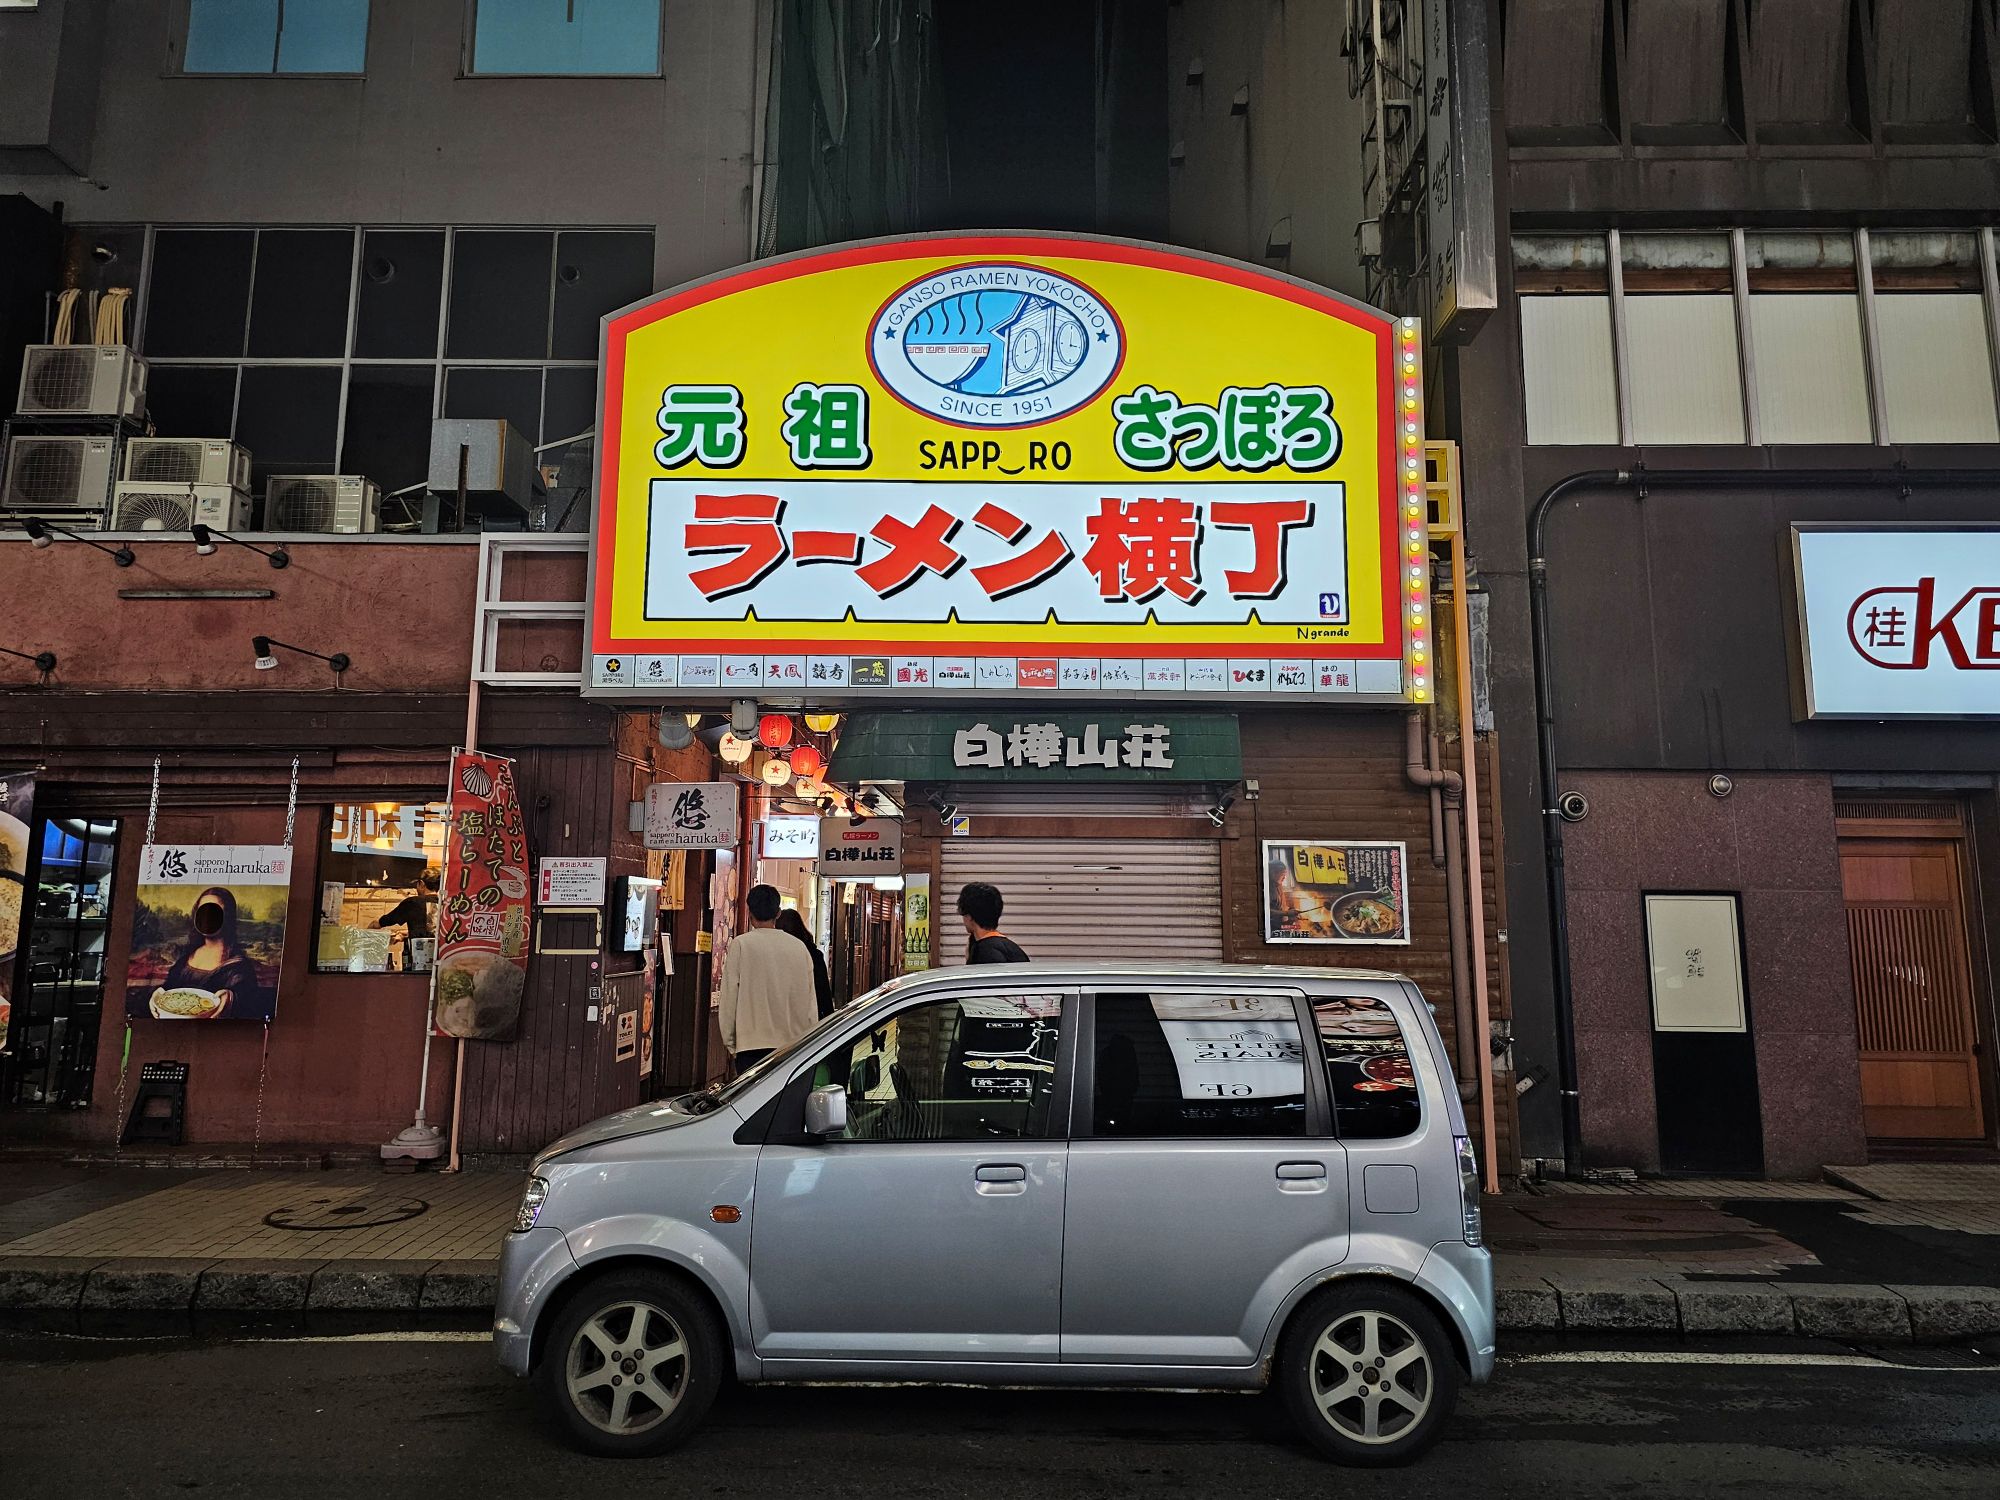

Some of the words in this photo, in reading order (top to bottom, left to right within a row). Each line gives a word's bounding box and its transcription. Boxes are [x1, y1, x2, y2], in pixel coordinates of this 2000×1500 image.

[888, 281, 946, 326] GANSO
[950, 272, 1018, 290] RAMEN
[1025, 274, 1105, 329] YOKOCHO
[940, 396, 1003, 417] SINCE
[1013, 396, 1053, 416] 1951
[1112, 384, 1343, 472] さっぽろ
[683, 493, 1315, 606] ラーメン横丁
[1311, 628, 1350, 640] grande
[1863, 606, 1907, 647] 桂
[1232, 670, 1265, 682] ひぐま
[953, 723, 1174, 768] 白樺山荘
[671, 788, 711, 830] 悠
[478, 803, 505, 906] ほたての
[675, 832, 718, 844] haruka
[825, 847, 895, 862] 白樺山荘
[158, 849, 189, 878] 悠
[194, 859, 225, 867] sapporo
[225, 861, 270, 874] haruka
[446, 810, 486, 944] 塩らーめん
